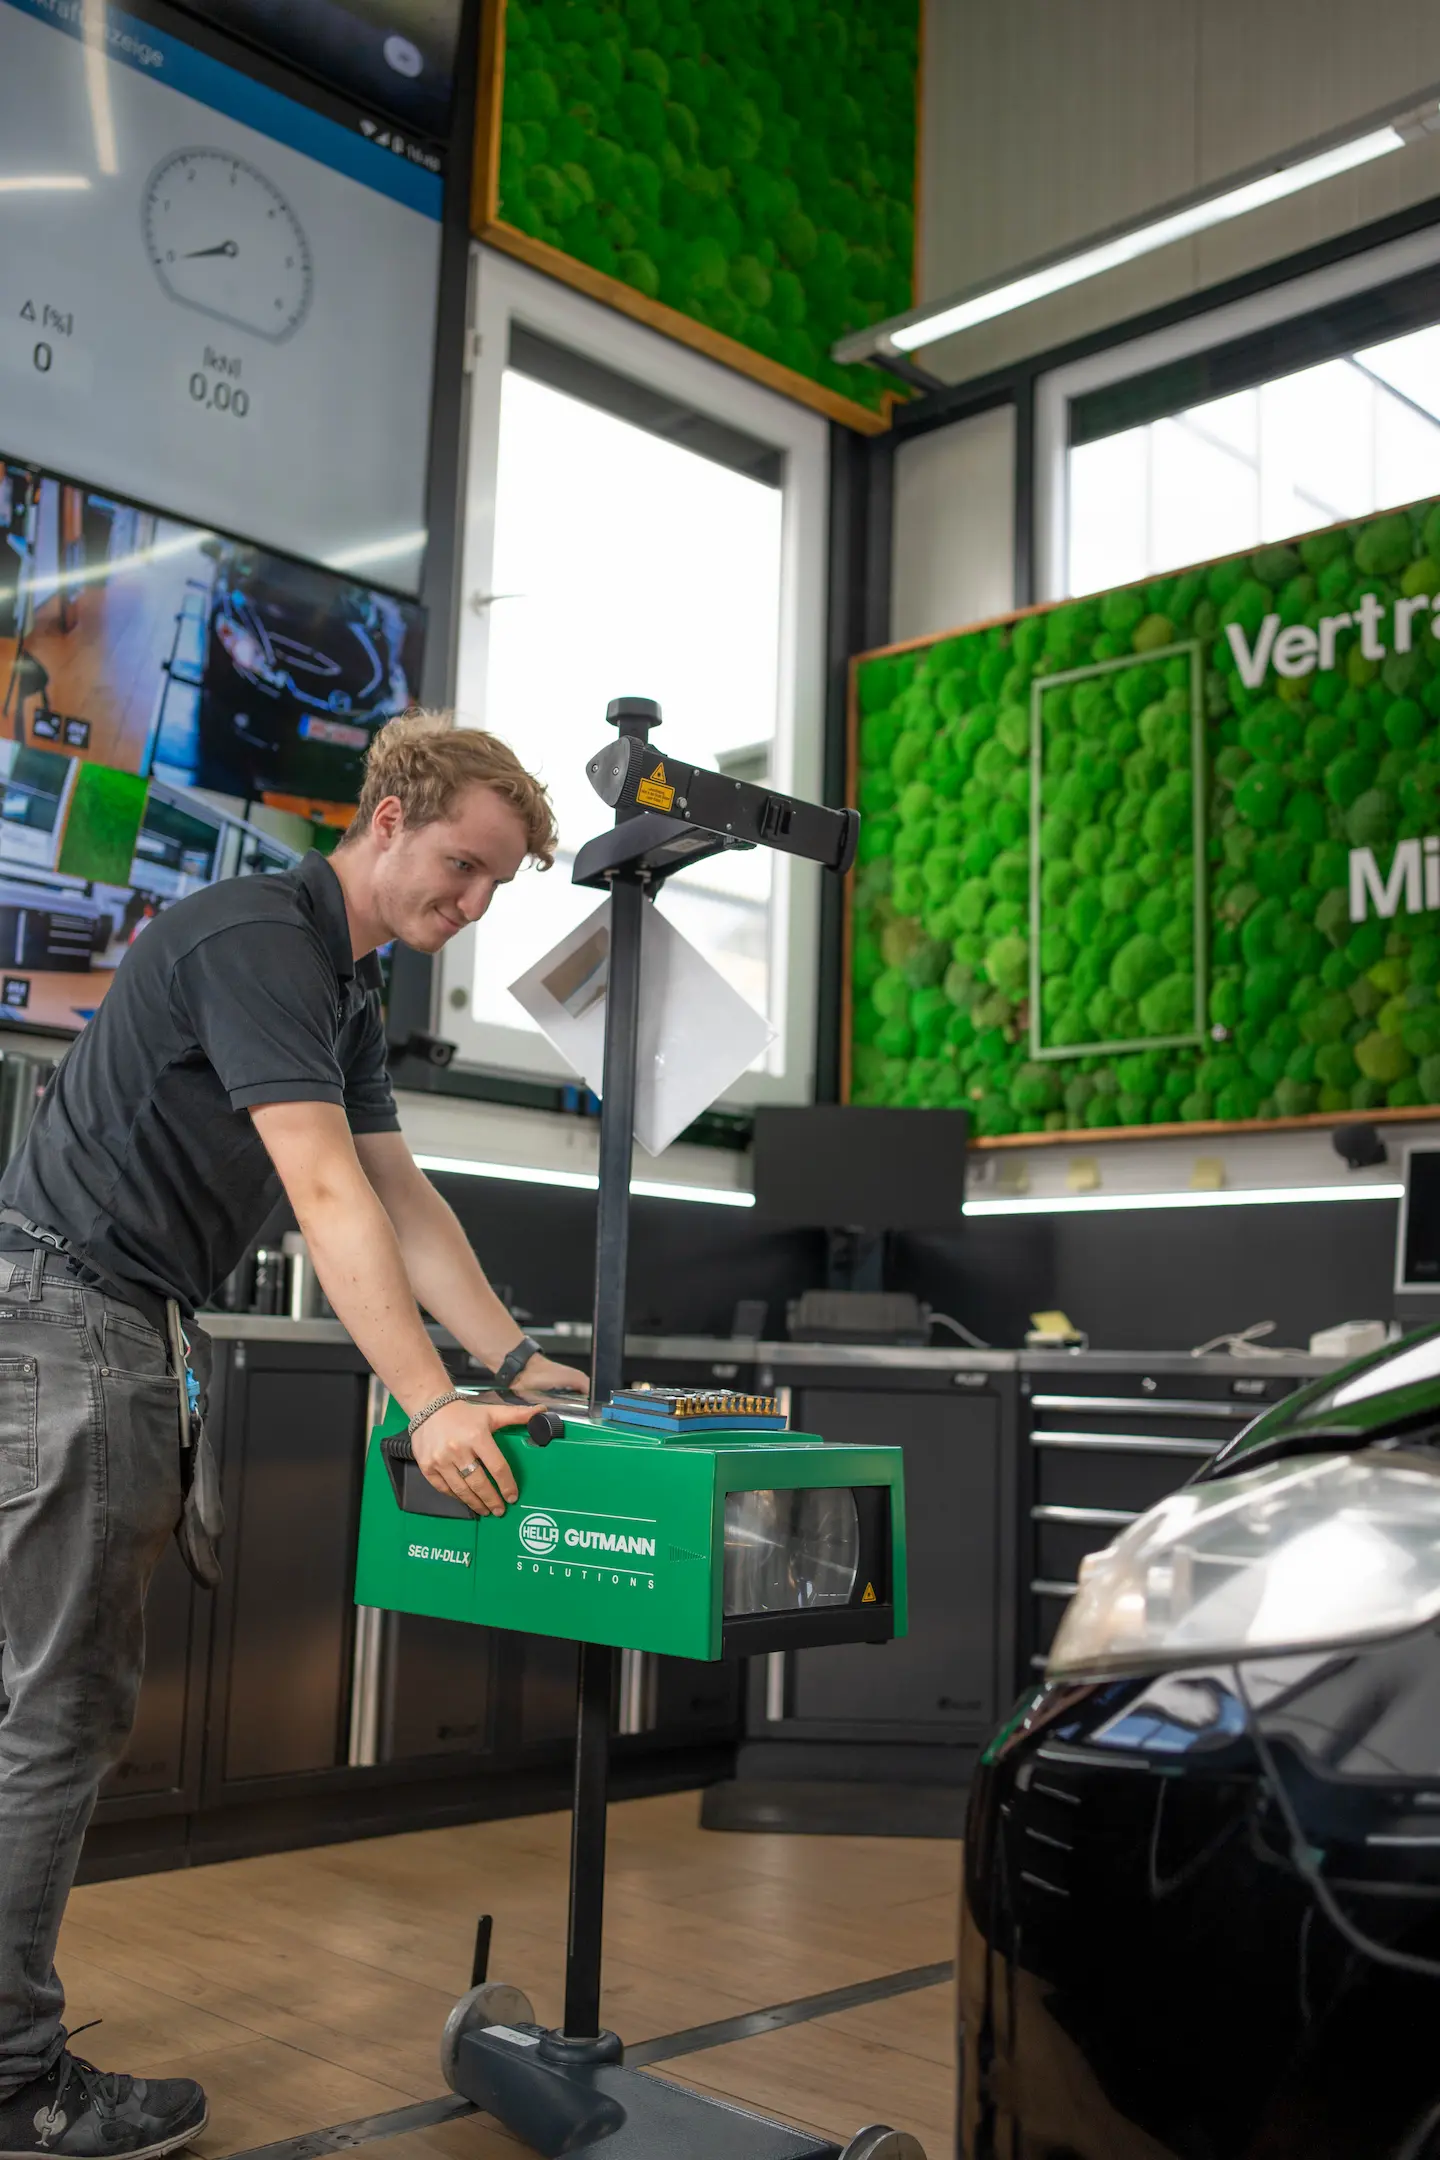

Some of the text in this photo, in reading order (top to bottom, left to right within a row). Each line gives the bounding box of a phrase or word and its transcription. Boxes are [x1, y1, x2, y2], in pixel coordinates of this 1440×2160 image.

[33, 341, 53, 374] 0
[189, 372, 249, 419] 0,00
[1349, 835, 1440, 923] Mi
[407, 1544, 471, 1566] SEG IV-DLLX
[523, 1526, 656, 1557] HELLA GUTMANN
[517, 1561, 655, 1590] SOLUTIONS
